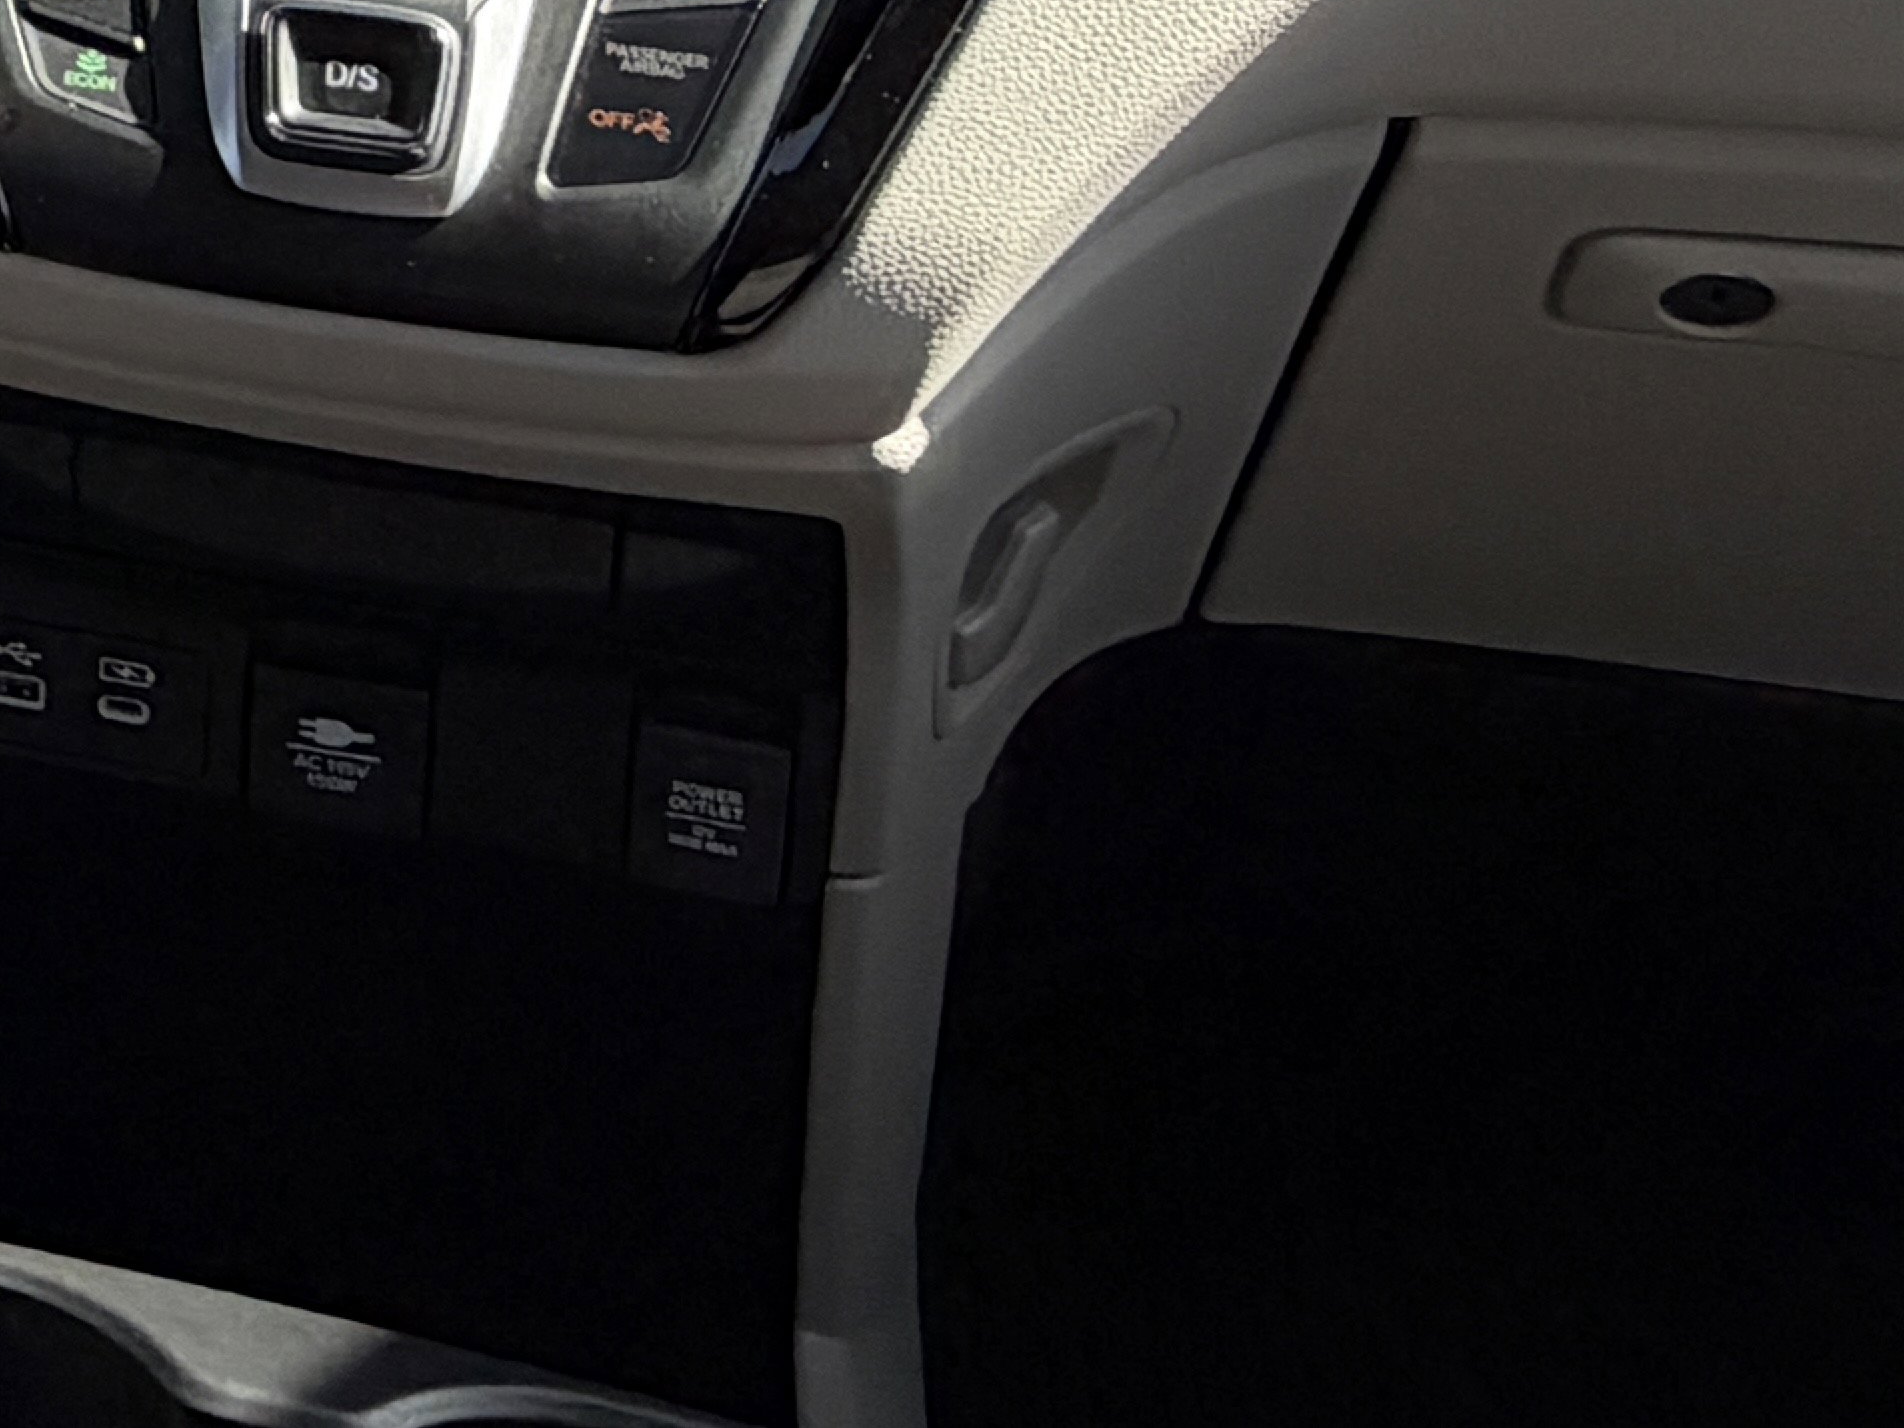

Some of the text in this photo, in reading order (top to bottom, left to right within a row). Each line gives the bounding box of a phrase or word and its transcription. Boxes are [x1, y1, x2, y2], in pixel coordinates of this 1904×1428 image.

[63, 69, 117, 93] ECON
[324, 60, 381, 93] D/S
[588, 108, 635, 131] OFF
[672, 779, 744, 806] POWER
[668, 794, 744, 822] OUTLET
